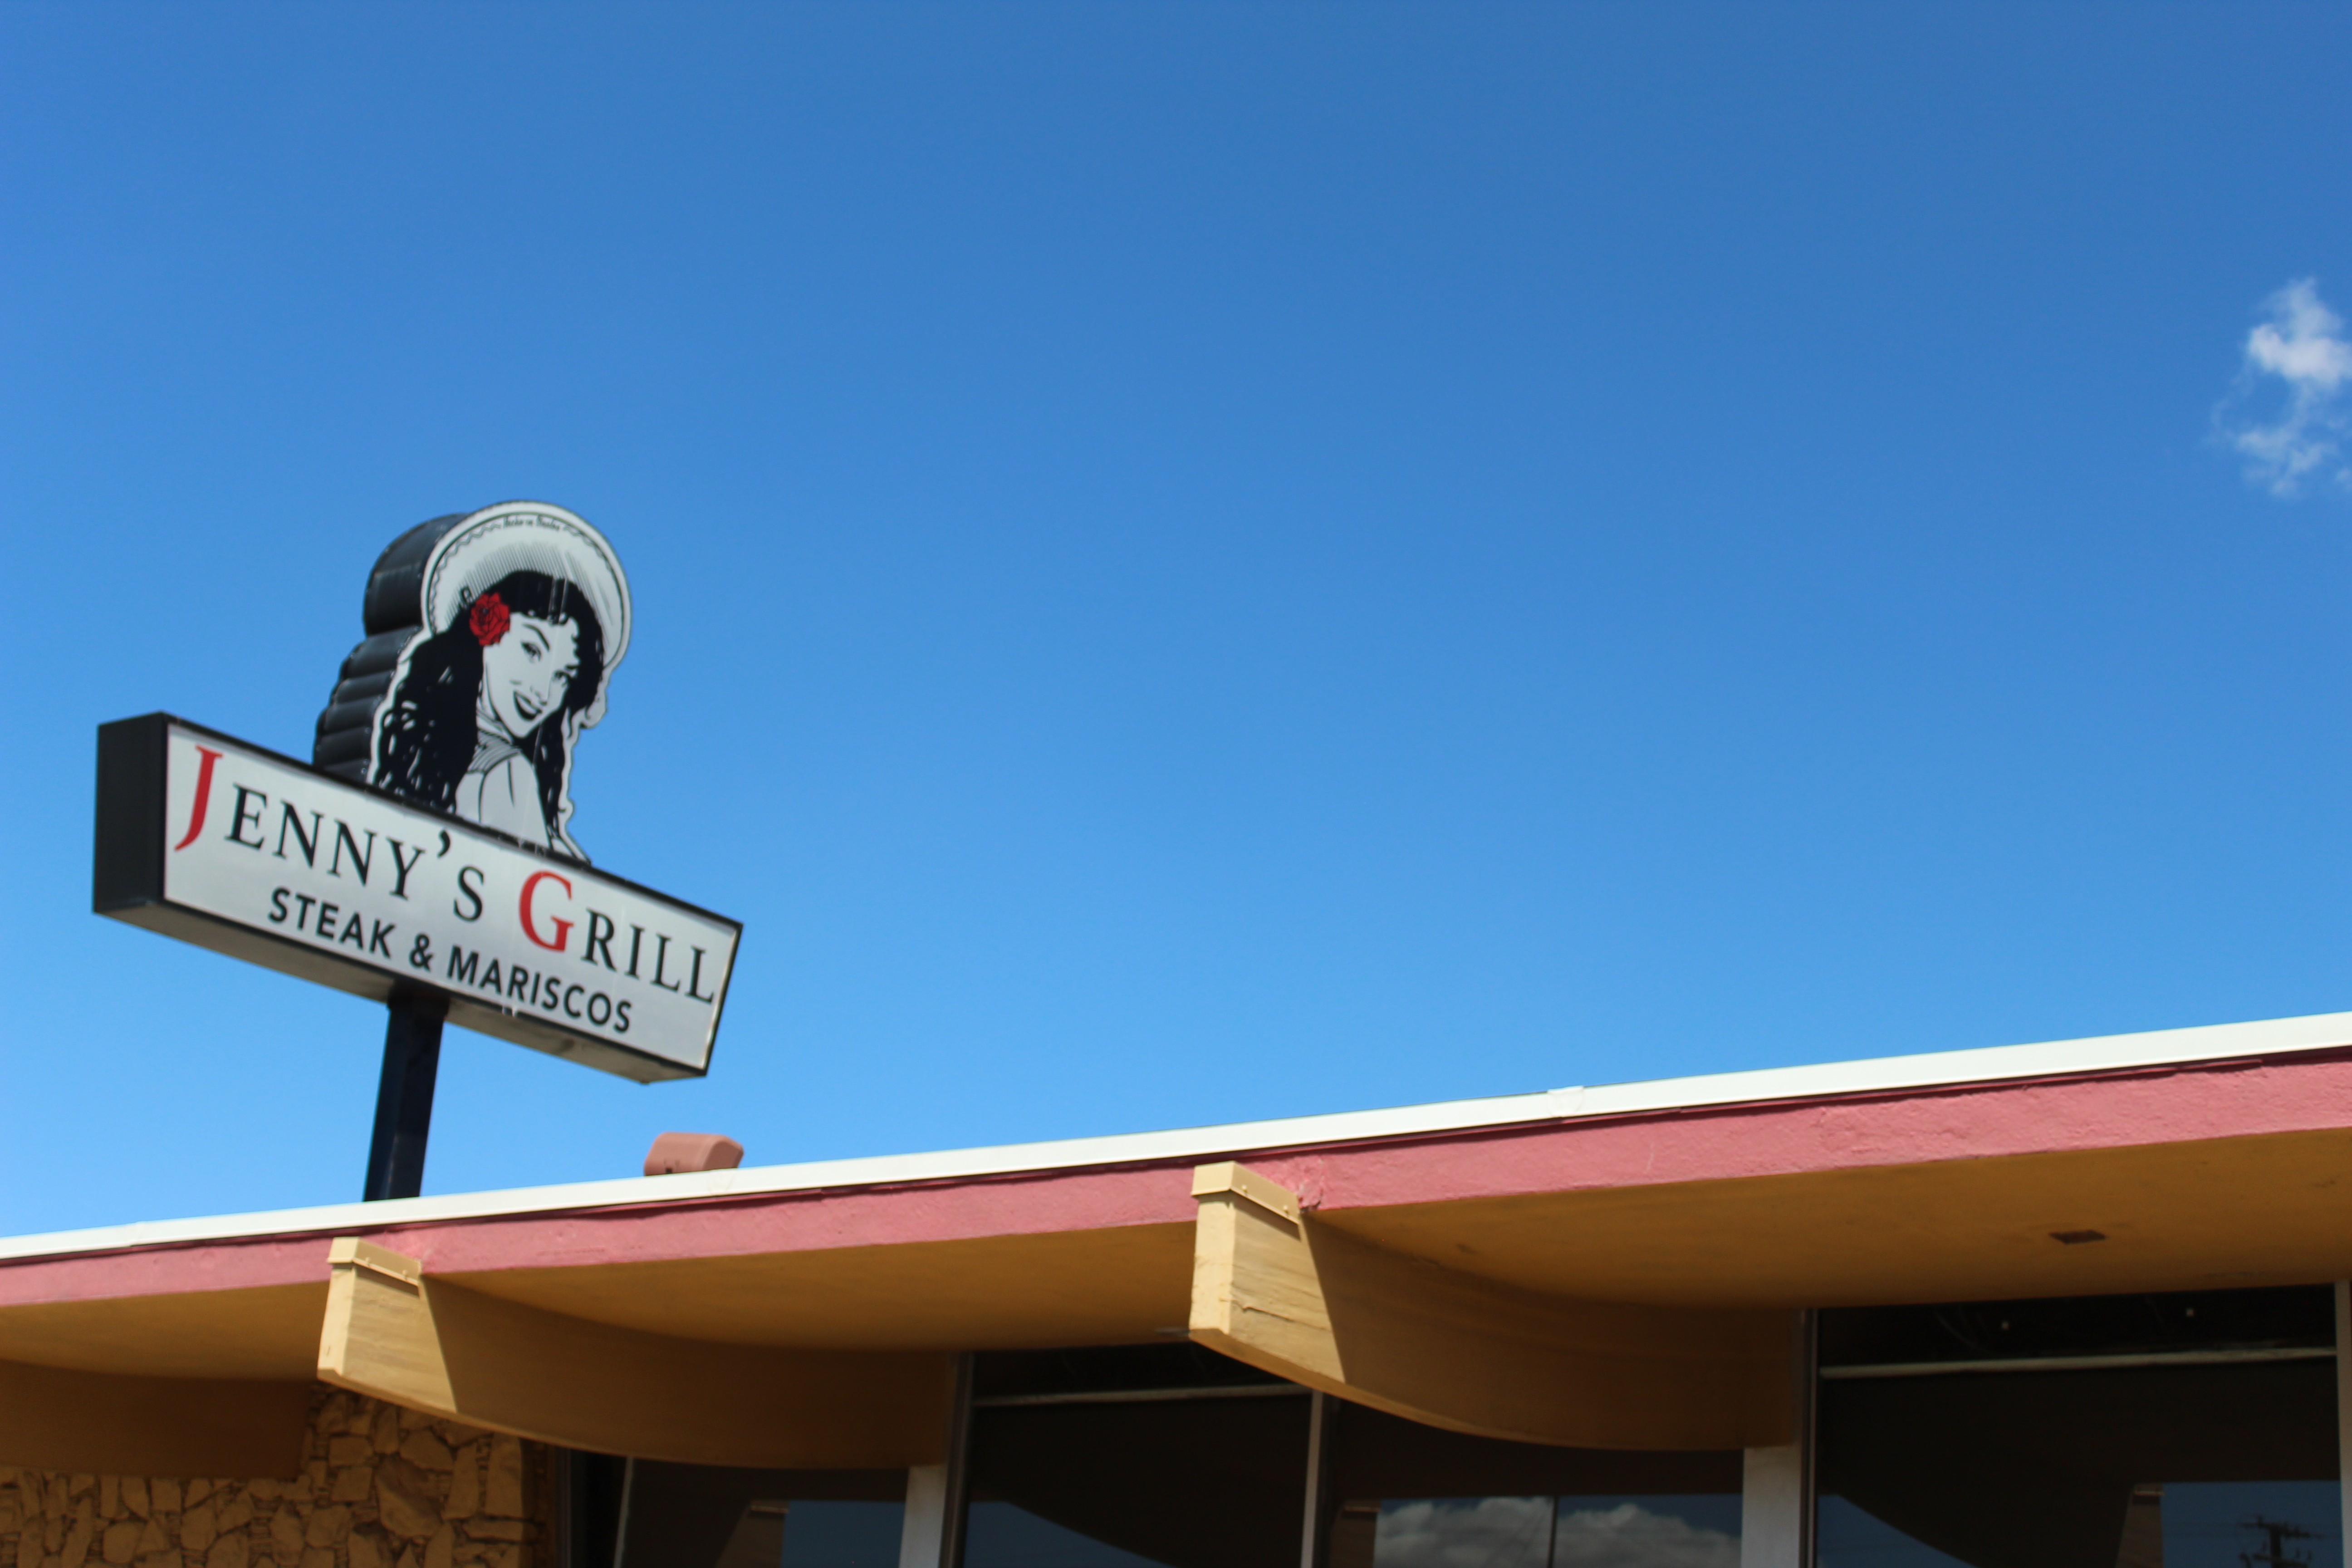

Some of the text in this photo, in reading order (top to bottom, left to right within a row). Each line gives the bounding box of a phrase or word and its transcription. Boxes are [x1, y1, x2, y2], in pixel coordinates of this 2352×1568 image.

[174, 745, 715, 1004] JENNY'S GRILL
[268, 887, 632, 1033] STEAK & MARISCOS
